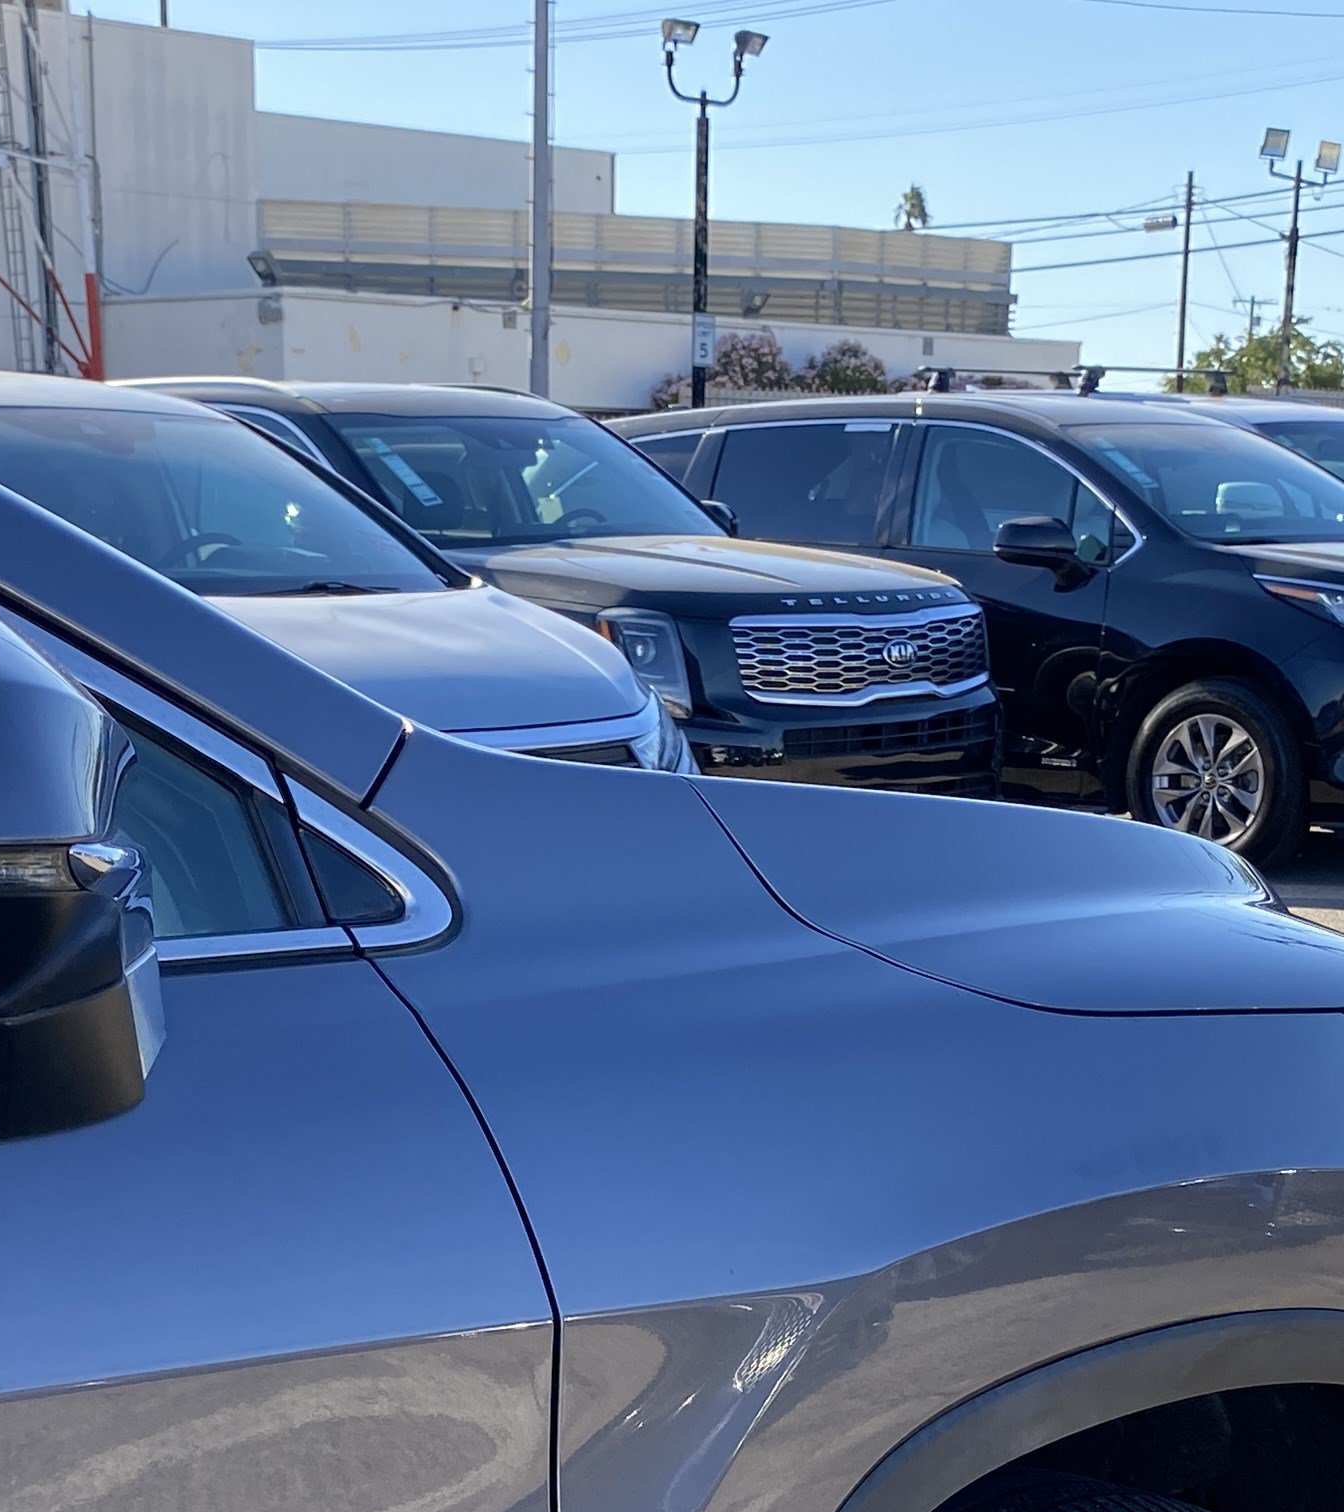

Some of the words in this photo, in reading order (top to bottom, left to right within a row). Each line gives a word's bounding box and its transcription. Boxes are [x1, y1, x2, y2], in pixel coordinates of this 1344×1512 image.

[700, 343, 708, 358] 5
[780, 591, 958, 608] TELLURIDE
[889, 644, 915, 663] KIA
